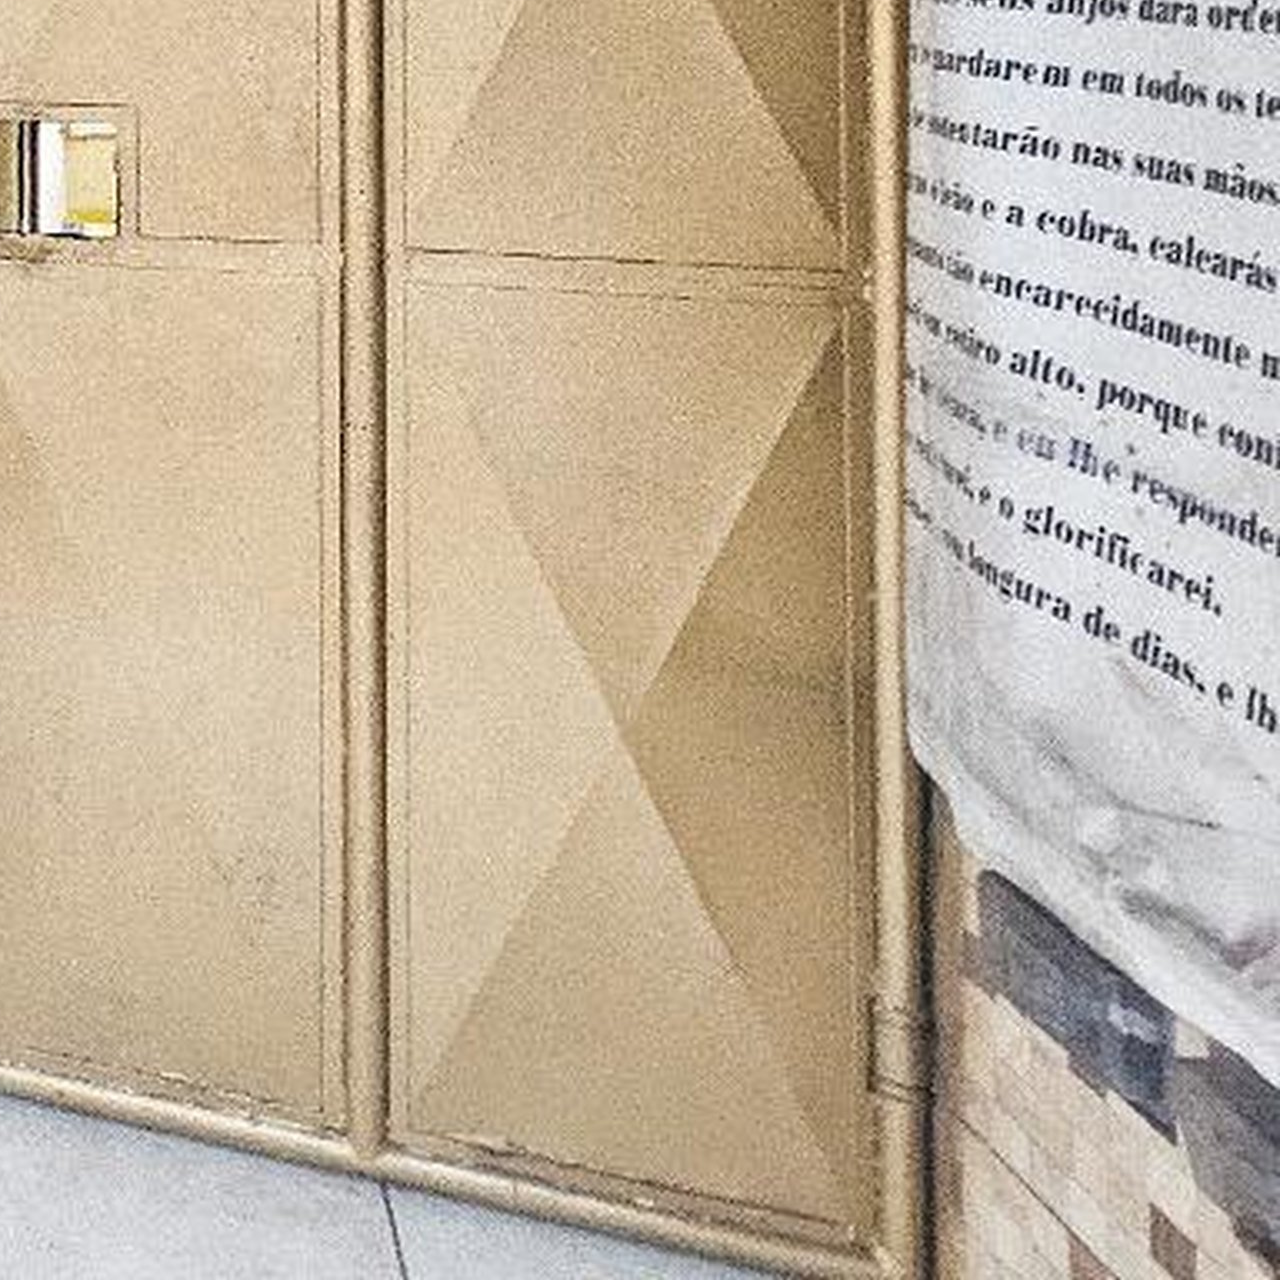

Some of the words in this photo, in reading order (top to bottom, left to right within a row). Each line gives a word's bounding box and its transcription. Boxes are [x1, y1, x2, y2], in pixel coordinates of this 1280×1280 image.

[1082, 68, 1126, 96] em
[1135, 69, 1209, 108] todos
[1216, 89, 1247, 114] os
[1072, 141, 1124, 171] nas
[1134, 152, 1196, 187] suas
[1005, 203, 1026, 228] a
[1096, 379, 1208, 439] porque
[1218, 422, 1280, 472] con
[999, 496, 1016, 521] o
[1082, 605, 1122, 645] de
[1216, 681, 1236, 708] e
[1245, 687, 1280, 735] lh
